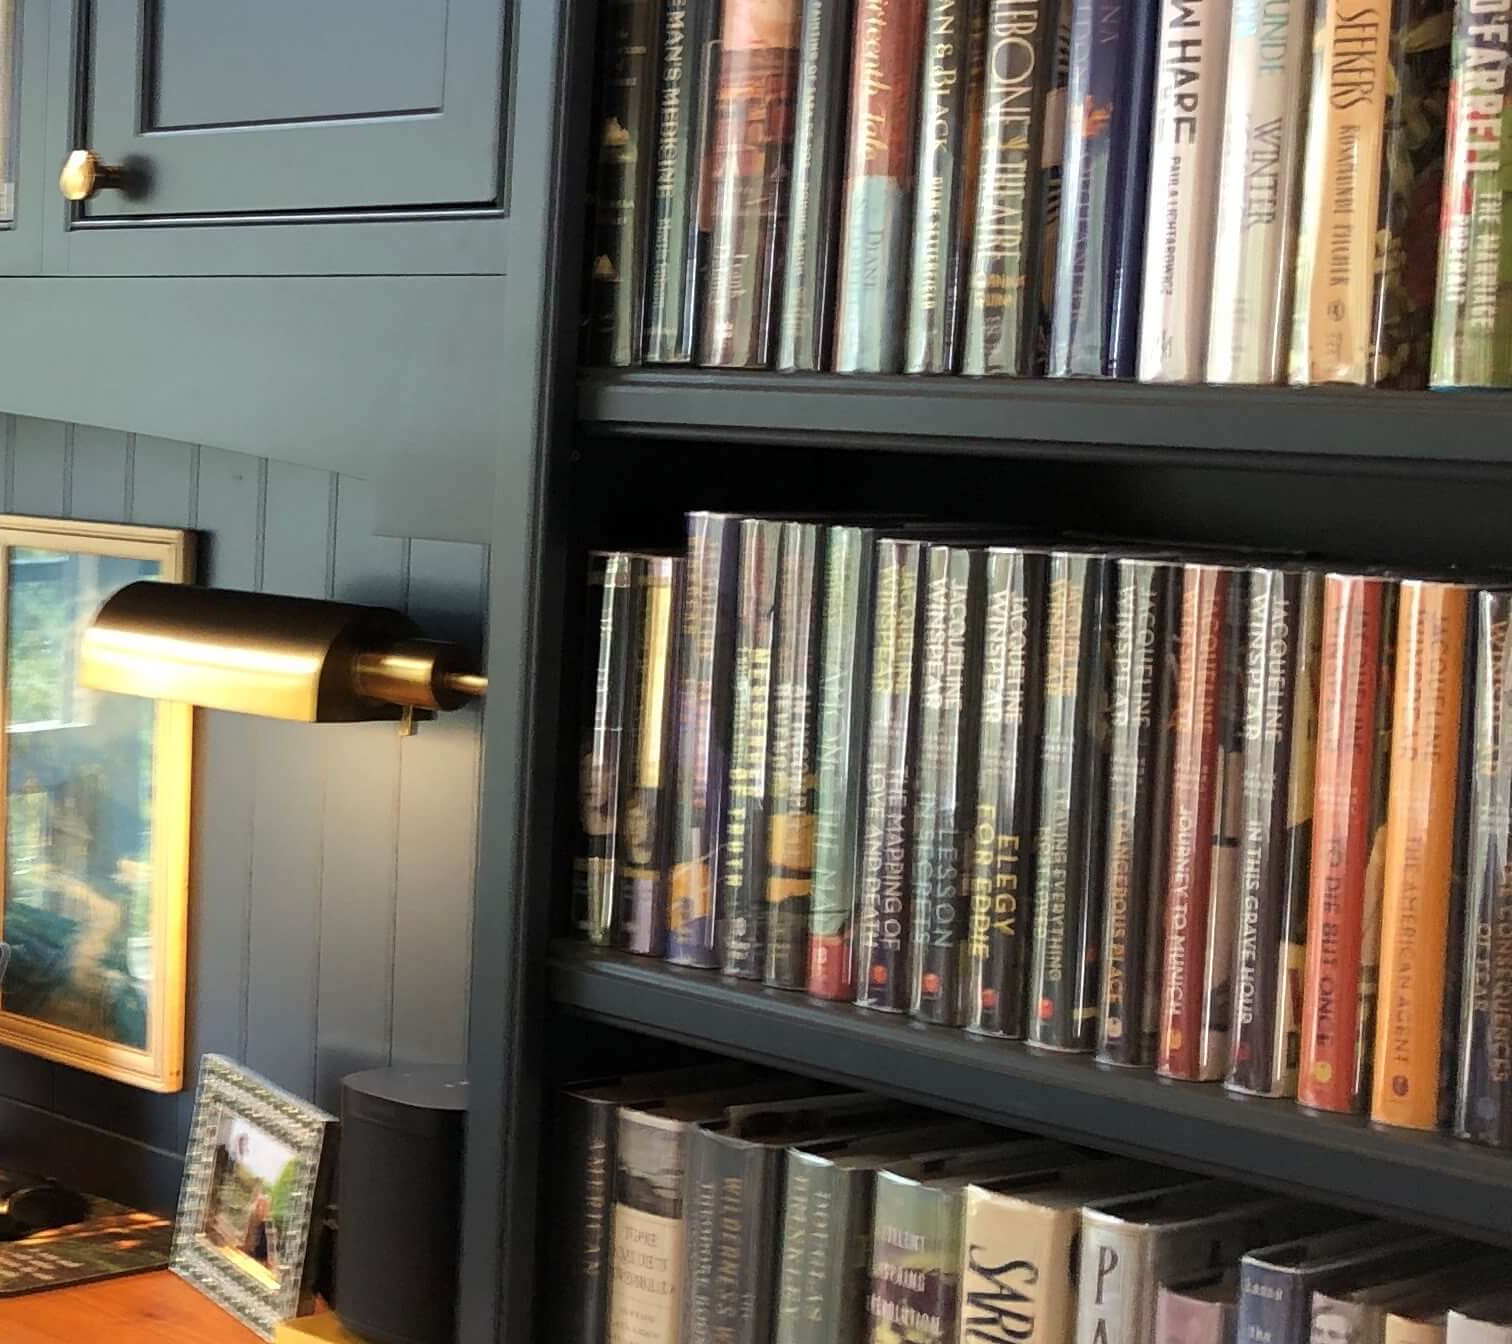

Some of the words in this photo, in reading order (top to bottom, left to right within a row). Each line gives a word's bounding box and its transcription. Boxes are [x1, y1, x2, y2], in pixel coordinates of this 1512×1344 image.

[663, 11, 685, 81] MAN'S
[933, 43, 953, 58] &
[1329, 6, 1380, 110] SEEKERS
[928, 64, 957, 155] BLACK
[1167, 40, 1203, 146] HARE
[657, 87, 681, 199] MEDICINE
[1168, 156, 1182, 198] PAULA
[1245, 118, 1283, 232] WINTER
[976, 159, 1028, 263] THEATRE
[1478, 191, 1503, 224] THE
[863, 229, 885, 291] DIANE
[1470, 232, 1498, 329] MARRIAGE
[926, 577, 947, 709] WINSPEAR
[945, 578, 968, 711] JACQUELINE
[987, 590, 1008, 722] WINSPEAR
[1004, 591, 1027, 724] JACQUELINE
[1112, 586, 1135, 727] WINSPEAR
[1136, 588, 1157, 729] JACQUELINE
[1241, 590, 1266, 740] WINSPEAR
[1263, 594, 1289, 743] JACQUELINE
[868, 764, 887, 808] LOVE
[889, 766, 908, 808] THE
[726, 808, 747, 887] TRUTH
[865, 816, 884, 872] AND
[884, 812, 904, 914] MAPPING
[977, 805, 995, 865] FOR
[1174, 803, 1194, 896] JOURNEY
[1244, 846, 1261, 890] THIS
[1247, 820, 1262, 841] IN
[1404, 836, 1421, 873] THE
[862, 877, 882, 949] DEATH
[934, 829, 958, 948] LESSON
[992, 834, 1019, 936] ELEGY
[1109, 819, 1128, 937] DANGEROUS
[1173, 903, 1188, 929] TO
[1323, 877, 1341, 912] DIE
[883, 918, 902, 952] OF
[970, 879, 992, 959] EDDIE
[1047, 868, 1064, 981] EVERYTHING
[1240, 897, 1257, 961] GRAVE
[1320, 922, 1337, 968] BUT
[1398, 880, 1420, 991] AMERICAN
[1107, 943, 1124, 1003] PLACE
[1169, 935, 1186, 1015] MUNICH
[1237, 967, 1255, 1025] HOUR
[1316, 977, 1334, 1049] ONCE
[1394, 996, 1413, 1064] AGENT
[715, 1176, 743, 1318] WILDERNESS
